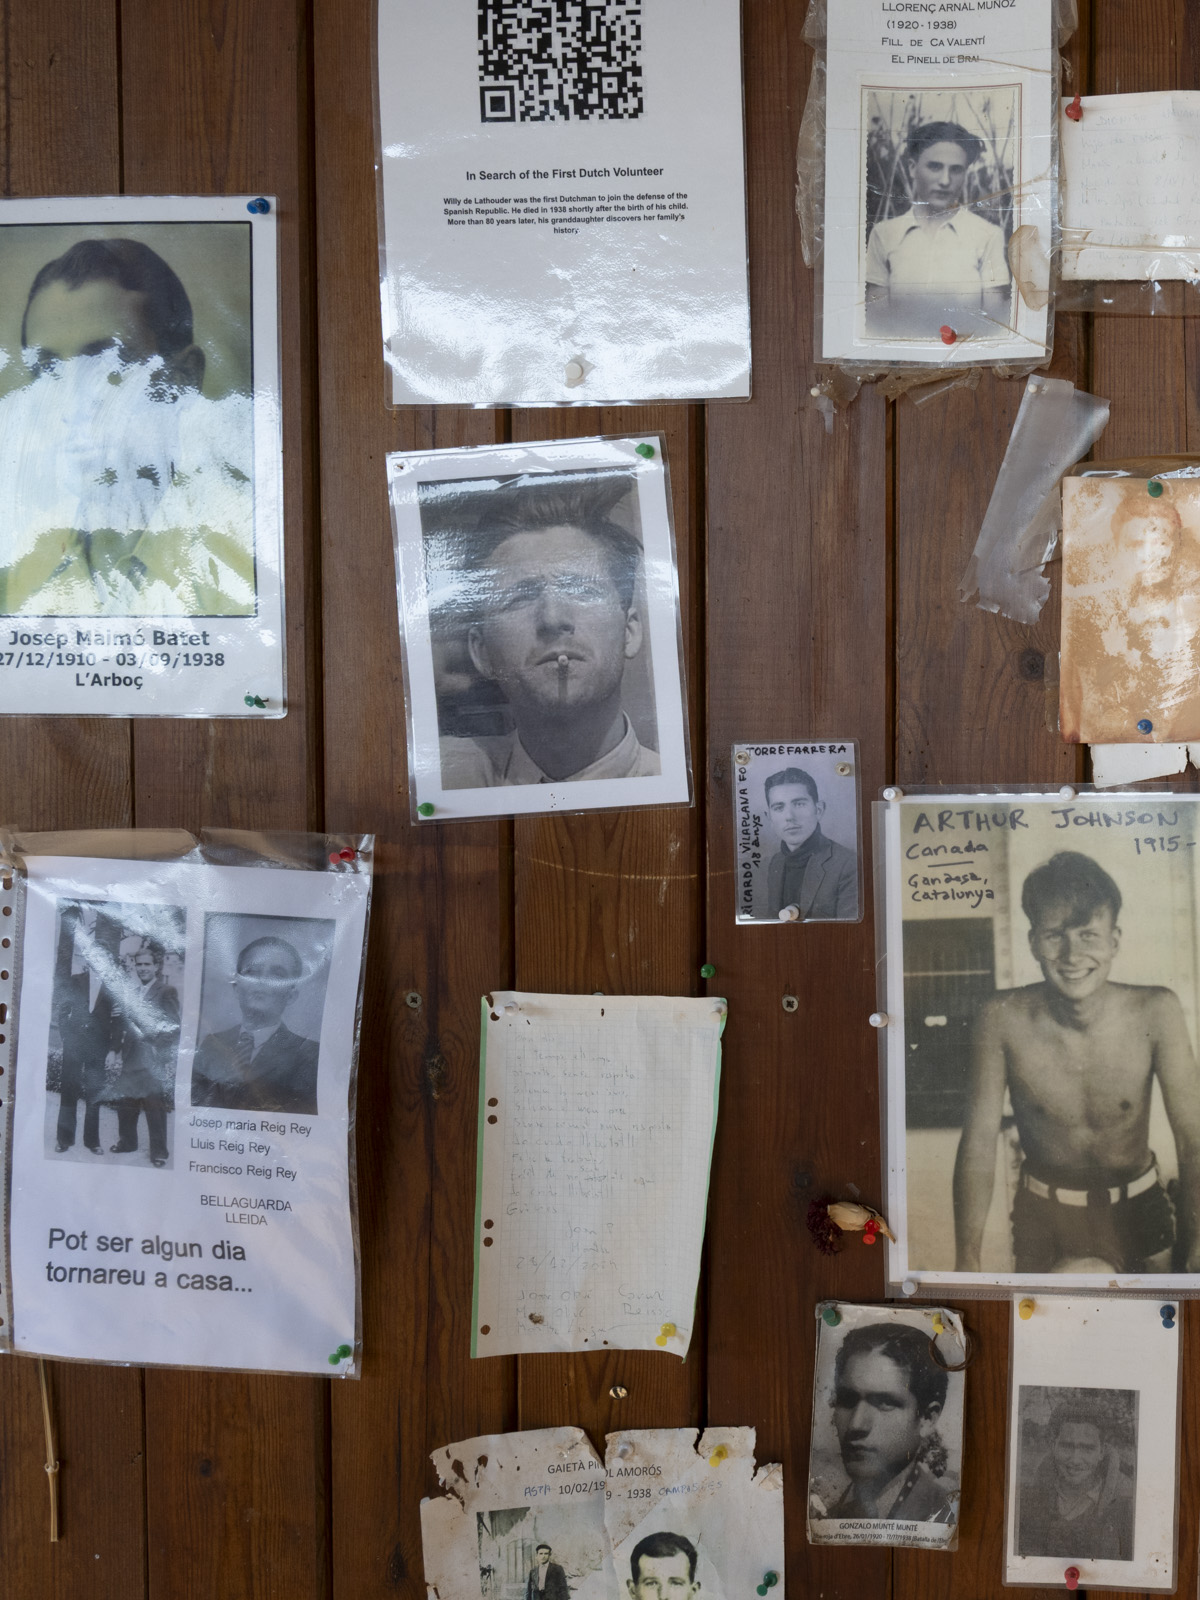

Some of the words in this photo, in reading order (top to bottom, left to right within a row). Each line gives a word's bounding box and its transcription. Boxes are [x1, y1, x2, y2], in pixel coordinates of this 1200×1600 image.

[882, 2, 936, 14] LLORENÇ
[939, 2, 975, 12] ARNAL
[466, 171, 476, 181] In
[479, 170, 516, 181] Search
[519, 169, 530, 180] of
[532, 169, 549, 179] the
[552, 169, 577, 179] First
[579, 168, 610, 178] Dutch
[613, 167, 664, 177] Volunteer
[443, 198, 462, 206] Willy
[474, 197, 512, 205] Lathouder
[559, 195, 597, 203] Dutchman
[607, 194, 622, 203] join
[636, 193, 666, 201] defense
[9, 630, 68, 648] Josep
[153, 630, 210, 646] Batet
[913, 808, 1029, 834] ARTHUR
[1050, 808, 1180, 830] JOHNSON
[906, 840, 989, 860] Canada
[190, 1116, 222, 1130] Josep
[226, 1120, 256, 1132] maria
[260, 1120, 286, 1136] Reig
[290, 1122, 312, 1138] Rey
[191, 1138, 215, 1151] Lluis
[218, 1139, 245, 1155] Reig
[248, 1141, 271, 1157] Rey
[189, 1160, 243, 1176] Francisco
[246, 1164, 272, 1180] Reig
[276, 1166, 297, 1181] Rey
[200, 1194, 293, 1212] BELLAGUARDA
[225, 1212, 268, 1226] LLEIDA
[48, 1228, 88, 1251] Pot
[96, 1235, 134, 1253] ser
[141, 1235, 203, 1260] algun
[212, 1240, 246, 1261] dia
[46, 1261, 145, 1286] tornareu
[154, 1272, 167, 1288] a
[176, 1273, 252, 1293] casa...
[548, 1460, 586, 1474] GAIETÀ
[617, 1464, 662, 1478] AMORÓS
[627, 1486, 652, 1500] 1938
[839, 1522, 871, 1530] GONZALO
[873, 1522, 894, 1530] MUNTÉ
[896, 1524, 918, 1532] MUNTÉ
